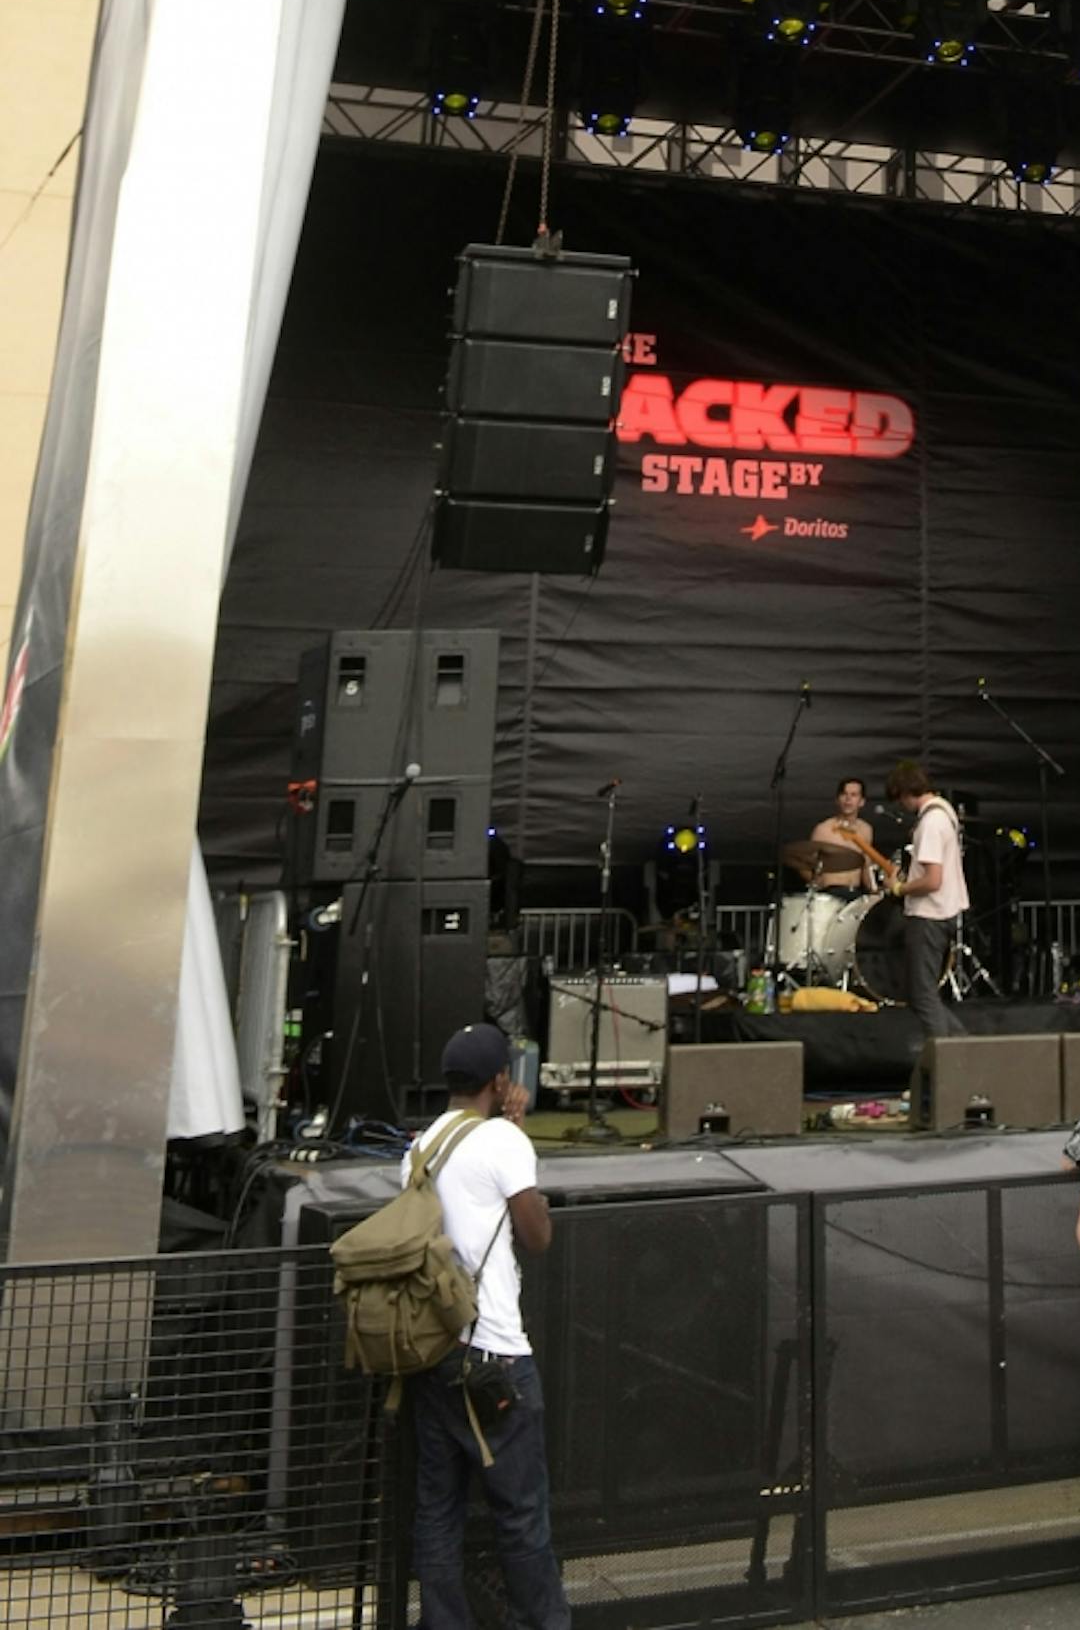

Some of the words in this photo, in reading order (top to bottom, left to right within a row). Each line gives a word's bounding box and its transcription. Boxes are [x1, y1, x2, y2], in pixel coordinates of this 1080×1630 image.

[614, 373, 914, 458] ACKED
[641, 454, 788, 499] STAGE
[790, 463, 823, 486] BY
[784, 517, 849, 539] Doritos
